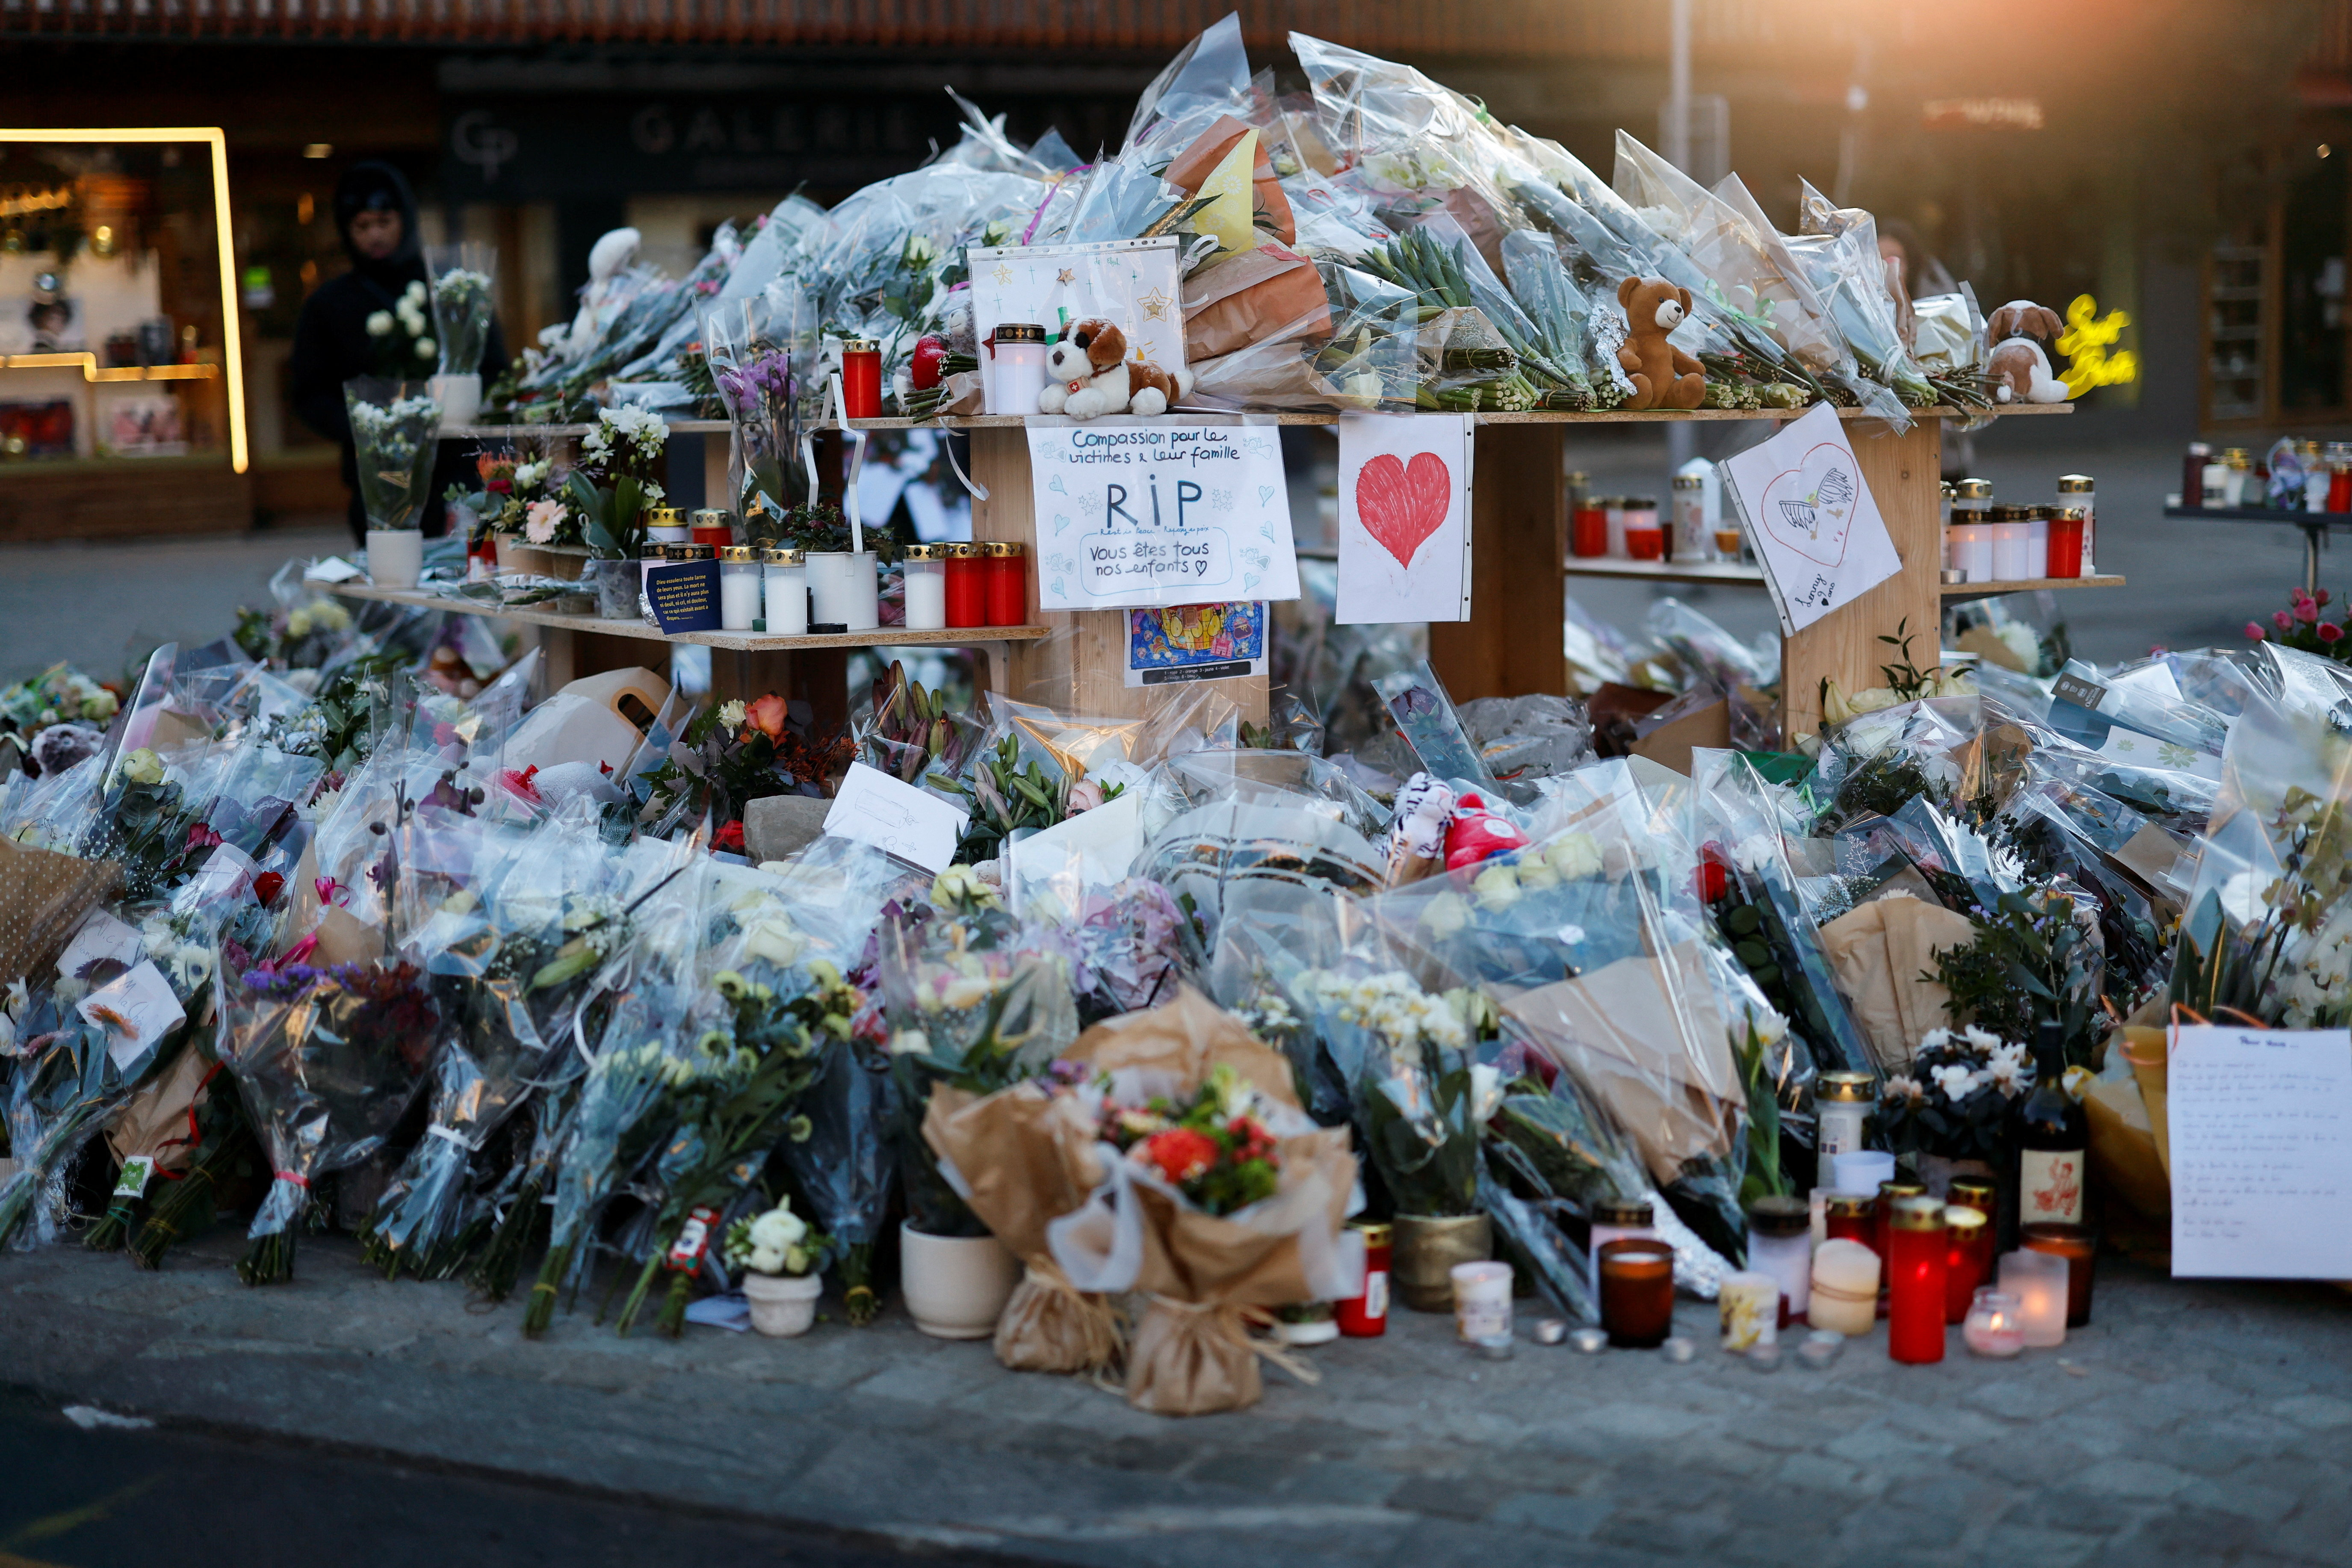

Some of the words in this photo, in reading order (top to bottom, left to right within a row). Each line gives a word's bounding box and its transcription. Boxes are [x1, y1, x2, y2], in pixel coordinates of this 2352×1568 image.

[628, 103, 913, 155] GALERIE
[1073, 429, 1165, 456] Compassion
[1171, 431, 1200, 449] pour
[1070, 449, 1131, 464] victimes
[1191, 446, 1241, 468] famille
[1132, 542, 1167, 558] êtes
[1173, 540, 1209, 558] tous
[1096, 564, 1122, 576] nos
[1125, 559, 1189, 578] enfants
[1794, 573, 1827, 608] Lenny
